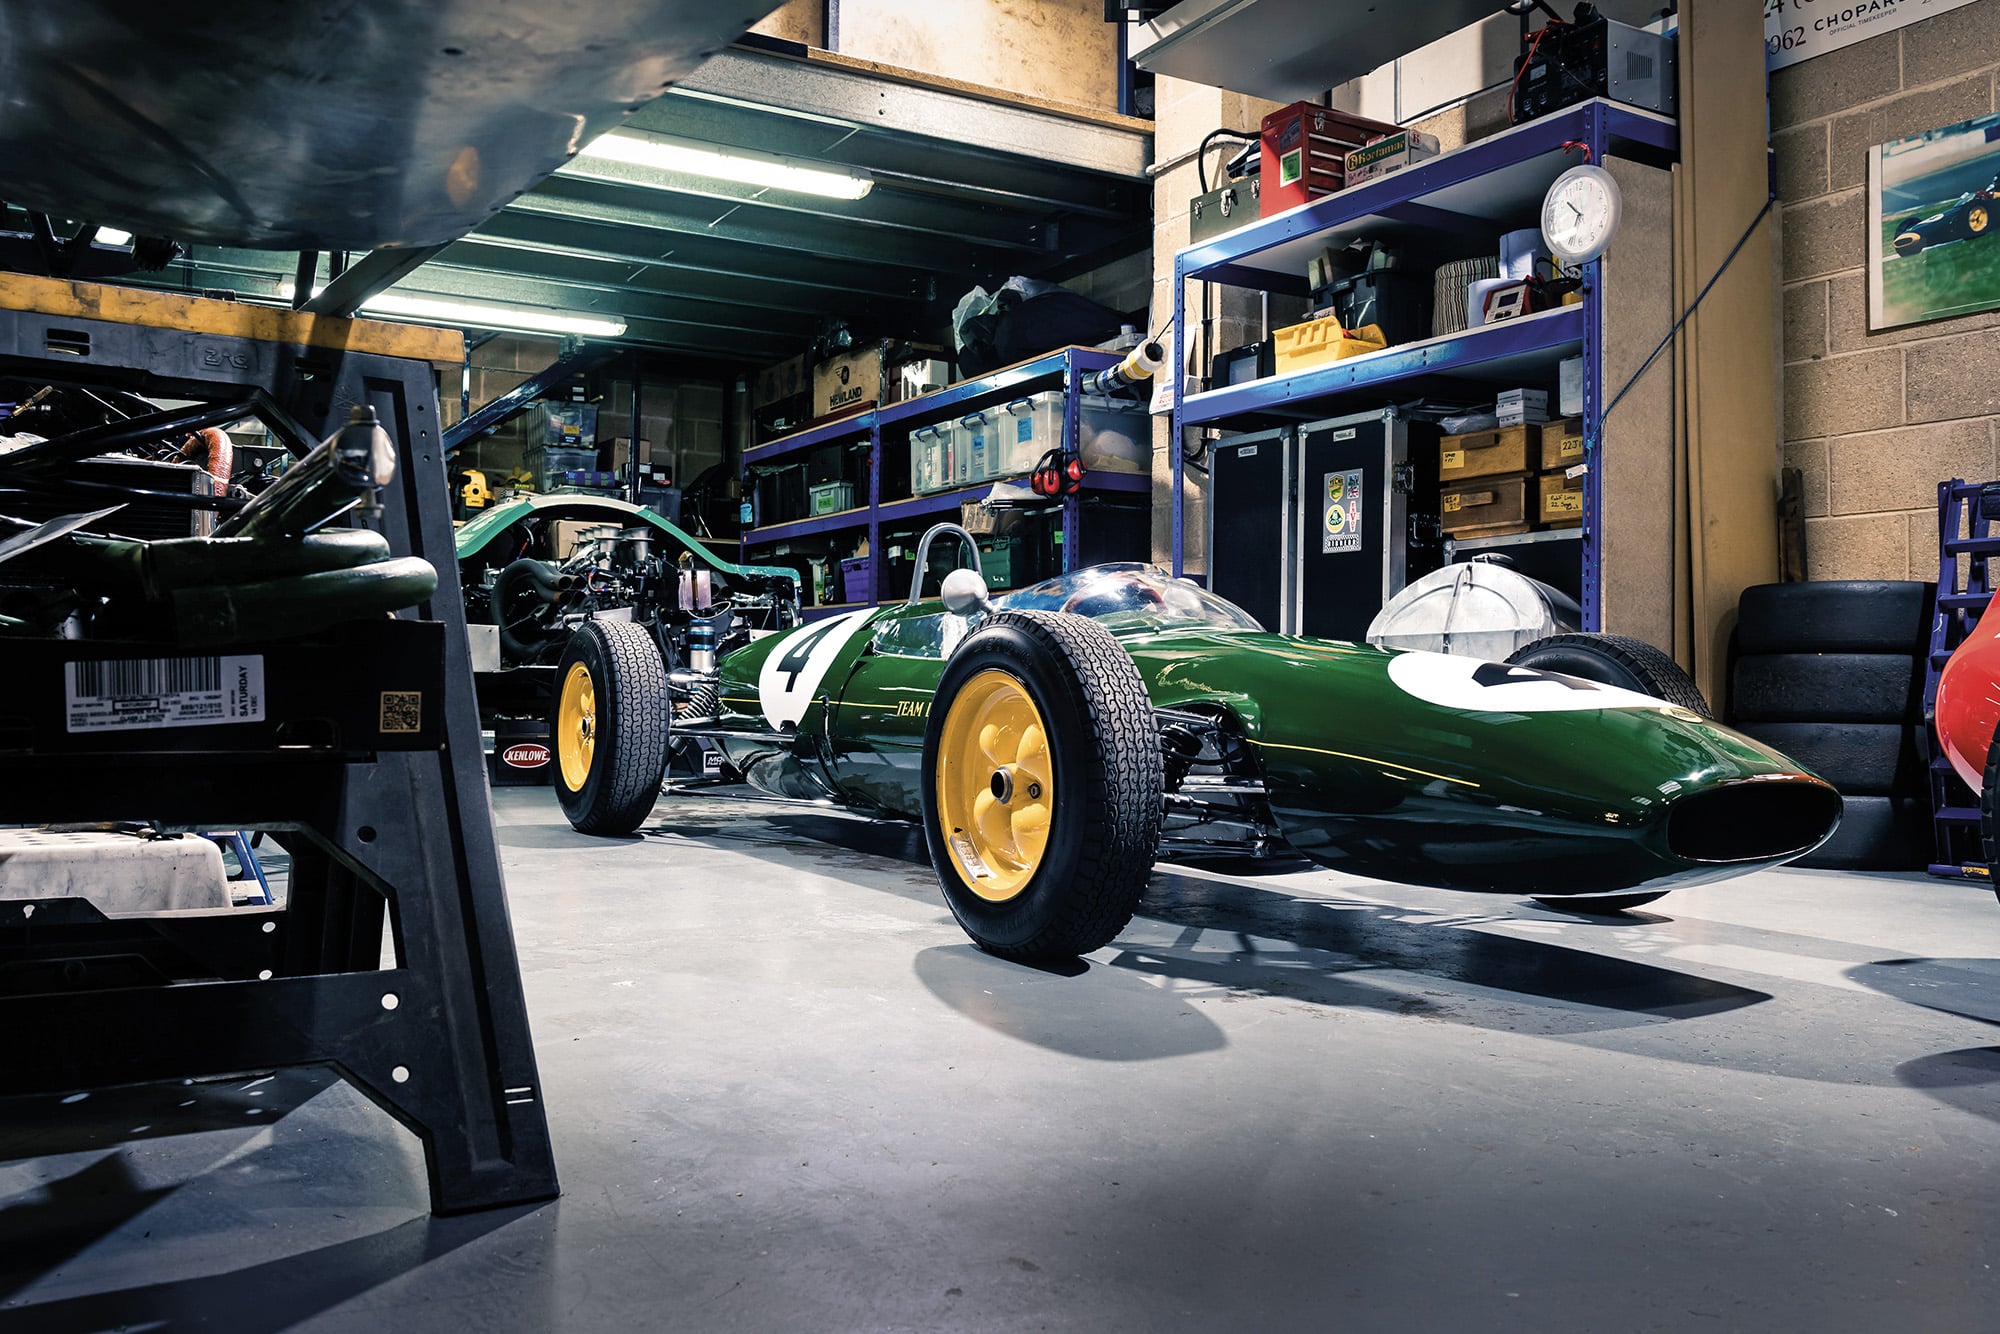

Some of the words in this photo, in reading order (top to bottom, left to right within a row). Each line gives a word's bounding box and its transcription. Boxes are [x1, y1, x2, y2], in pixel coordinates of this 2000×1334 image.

[1813, 0, 1905, 32] CHOPAR
[1829, 22, 1857, 36] OFFICIAL
[1858, 7, 1898, 26] TIMEKEEPER
[776, 616, 853, 692] 4
[238, 665, 248, 717] SATURDAY
[1471, 662, 1601, 691] 4
[896, 701, 924, 717] TEAM
[507, 749, 548, 762] KENLOWE
